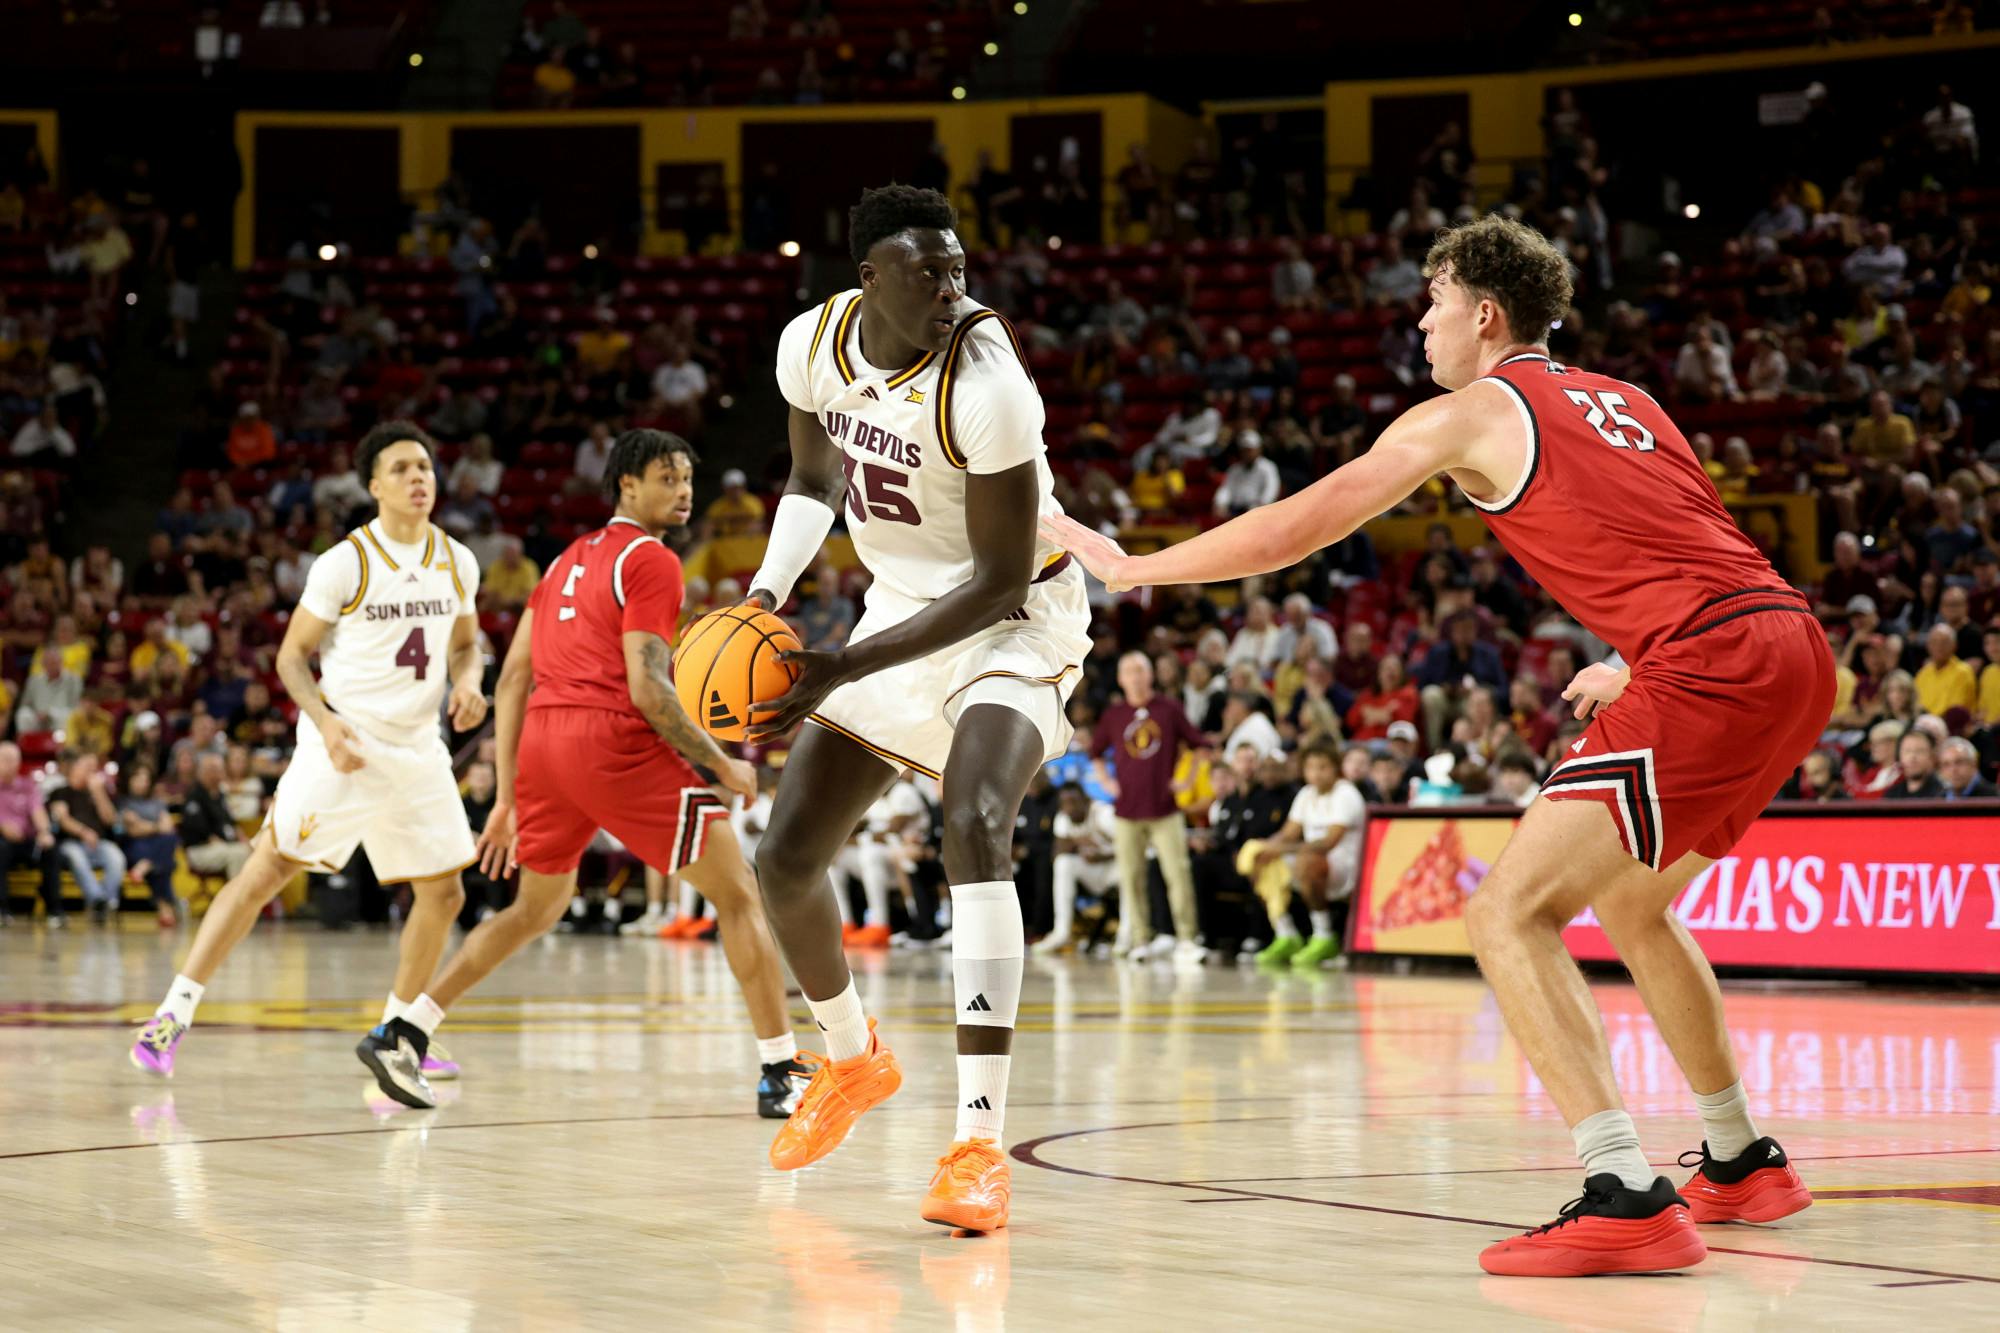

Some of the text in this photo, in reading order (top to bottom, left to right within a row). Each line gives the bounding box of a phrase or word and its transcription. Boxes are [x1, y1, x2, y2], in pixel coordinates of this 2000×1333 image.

[826, 411, 922, 468] UN DEVILS
[1561, 387, 1656, 452] 25
[365, 604, 401, 621] SUN
[395, 627, 431, 680] 4
[1673, 856, 1826, 934] ZIA'S
[1833, 863, 1976, 929] NEW
